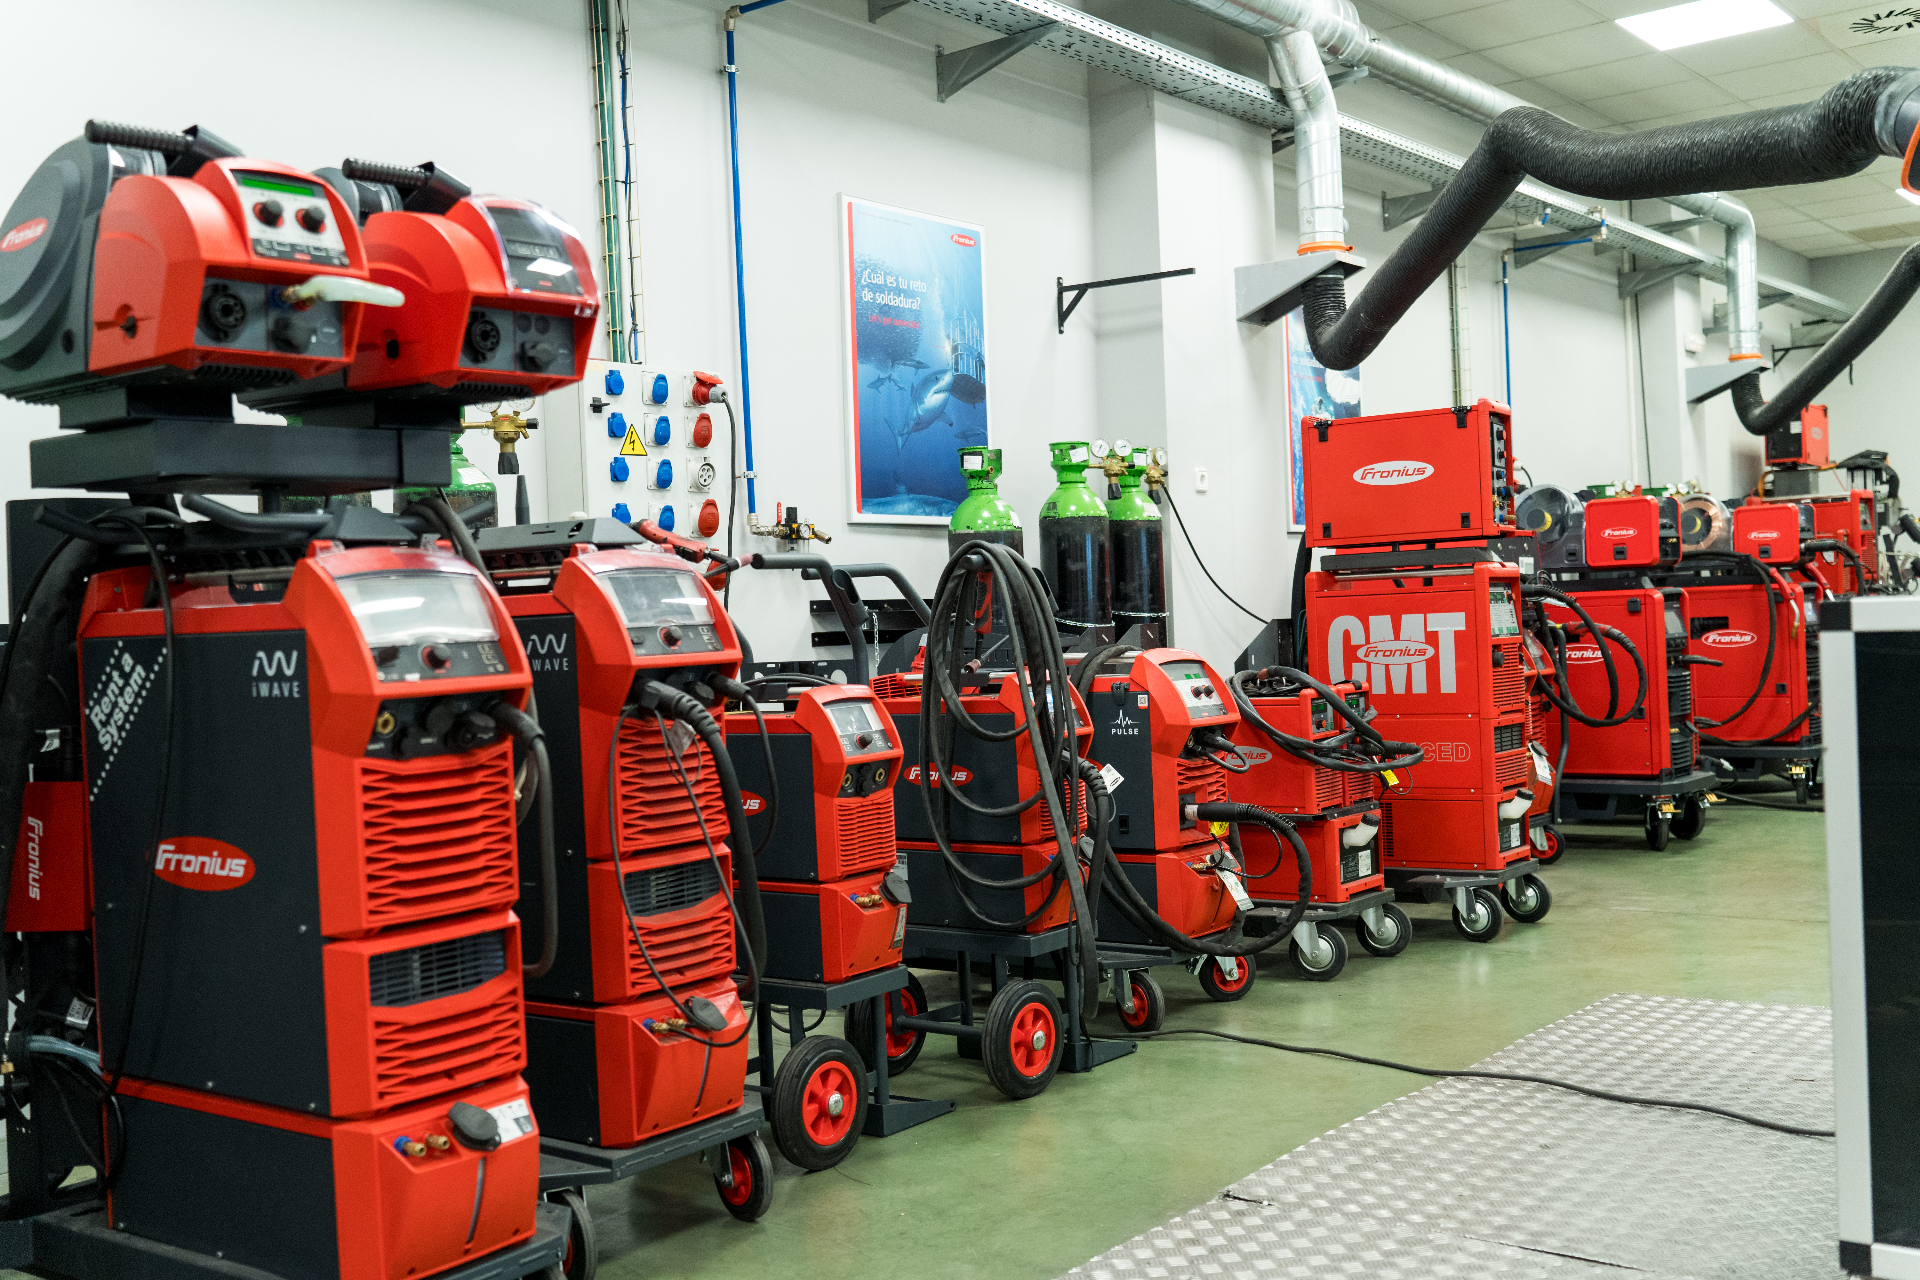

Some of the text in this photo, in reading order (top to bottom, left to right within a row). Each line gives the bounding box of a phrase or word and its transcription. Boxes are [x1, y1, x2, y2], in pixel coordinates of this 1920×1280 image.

[952, 234, 975, 246] Fronius
[861, 269, 927, 292] ¿Cuál es tu reto
[862, 287, 921, 310] de soldadura?
[1359, 465, 1428, 481] Fronius
[1604, 528, 1634, 537] Fronius
[1707, 634, 1752, 643] Fronius
[1327, 611, 1466, 695] CMT
[1363, 645, 1429, 658] Fronius
[89, 652, 134, 732] Rent a
[251, 680, 301, 698] iWAVE
[98, 664, 147, 752] System
[27, 816, 43, 901] Fronius
[154, 844, 247, 878] Fronius
